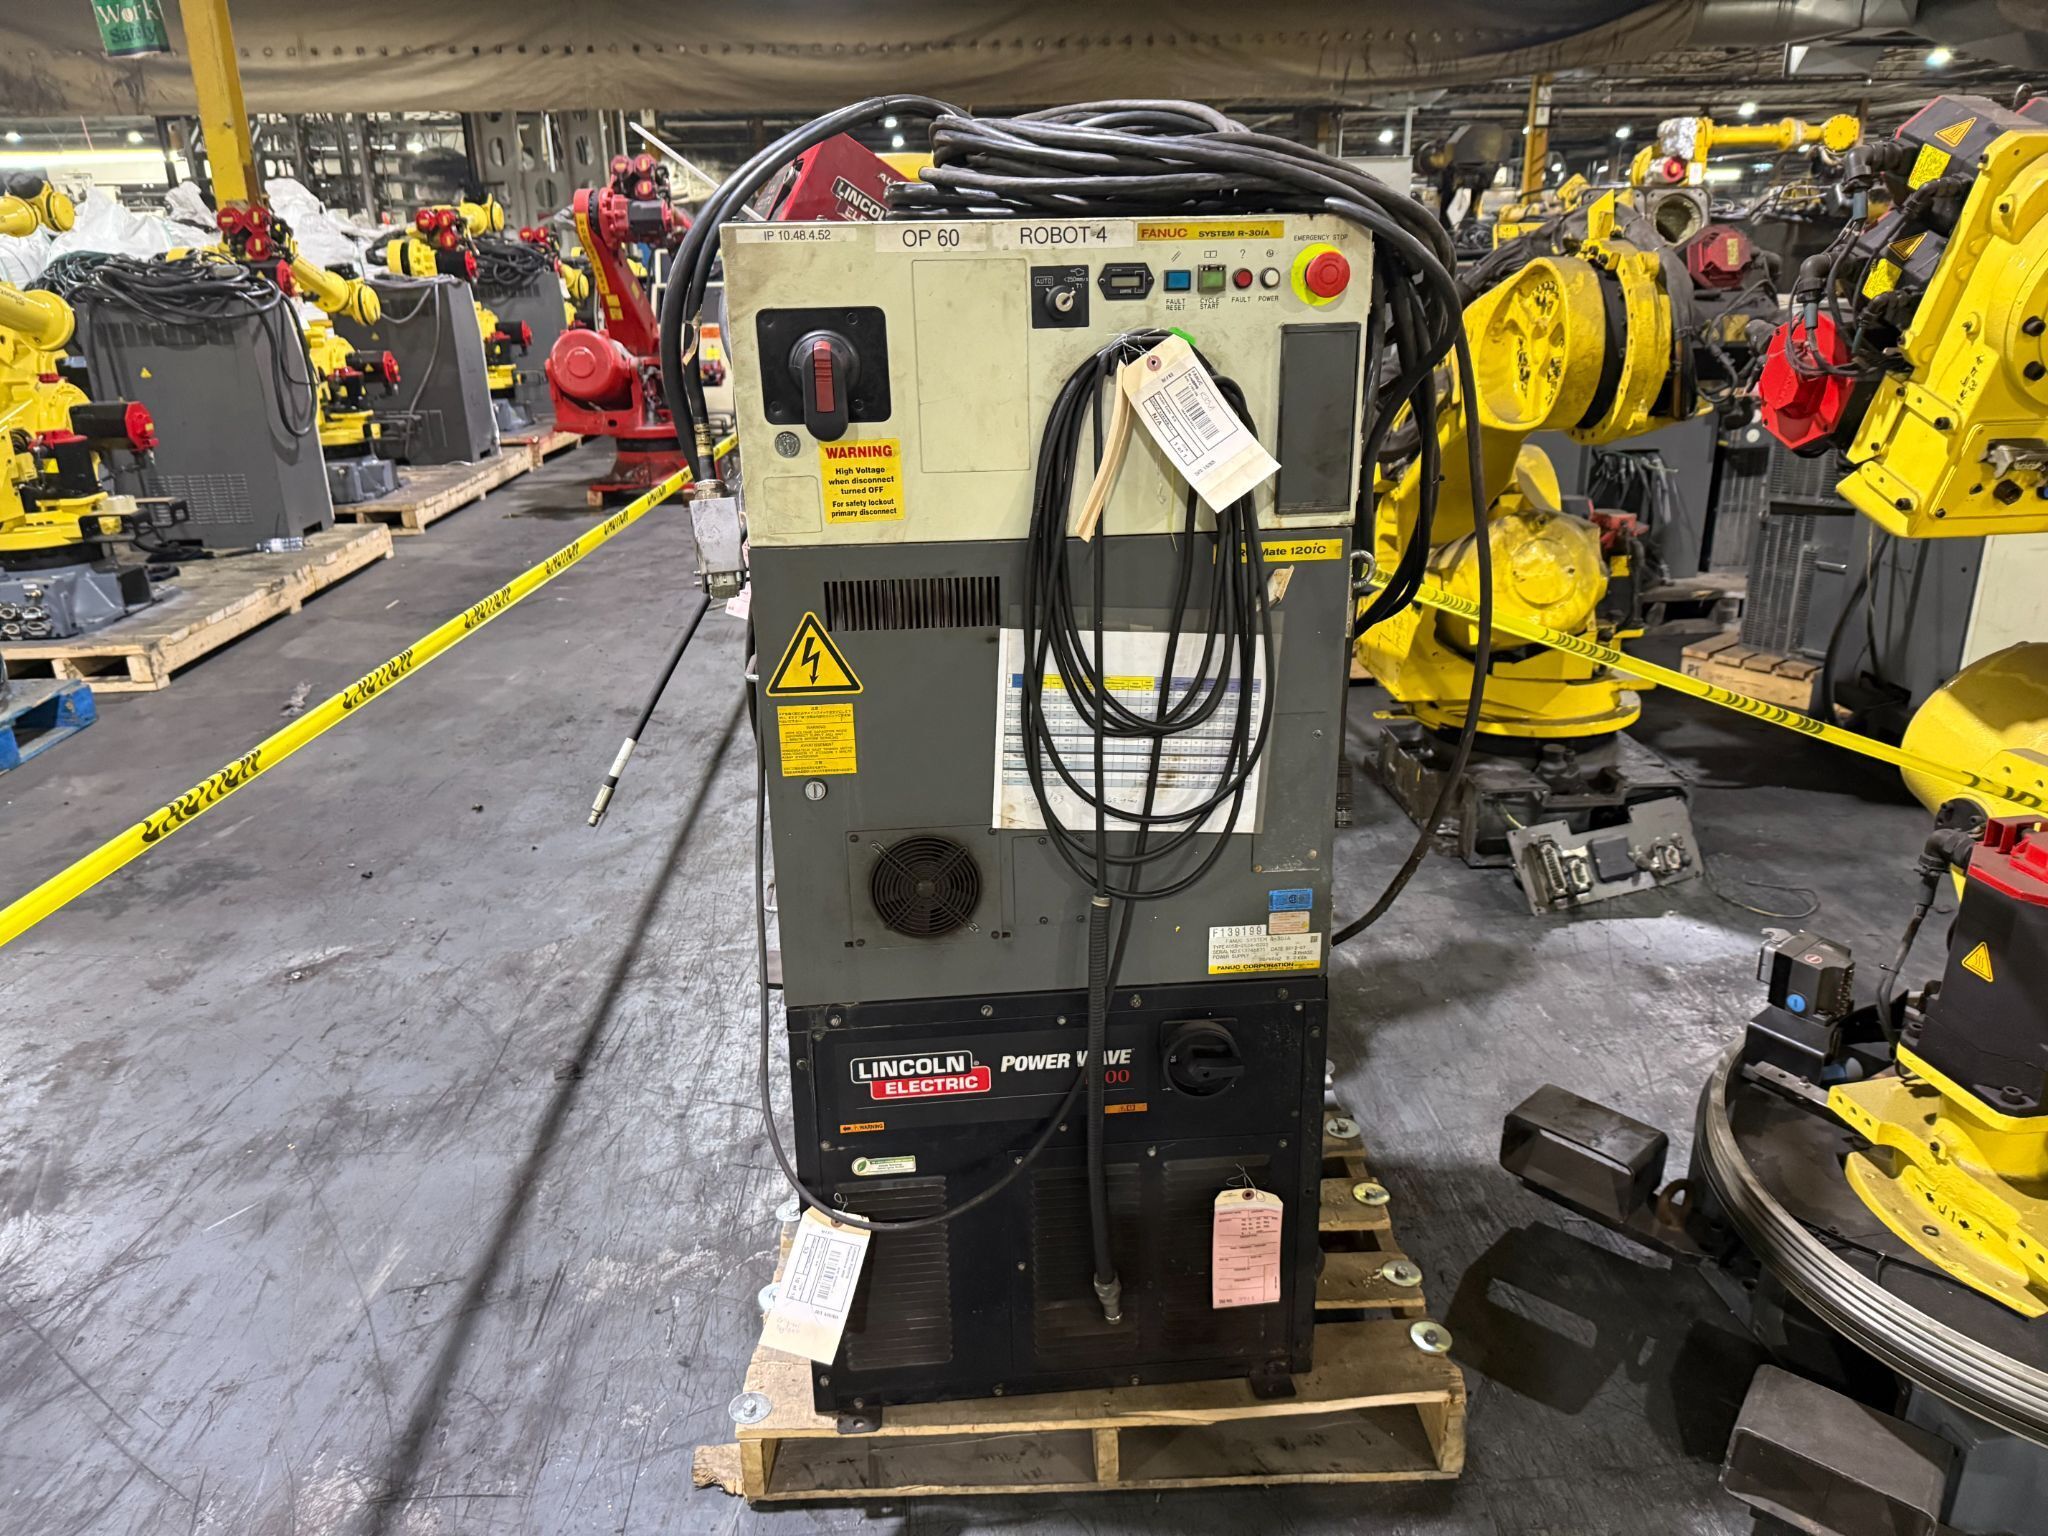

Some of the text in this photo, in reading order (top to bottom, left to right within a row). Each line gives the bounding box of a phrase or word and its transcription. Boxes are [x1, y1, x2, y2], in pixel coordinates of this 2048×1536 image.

[97, 0, 159, 24] Work
[763, 230, 831, 242] IP 10.48.4.52
[902, 228, 960, 247] OP 60
[1020, 226, 1107, 244] ROBOT 4
[1141, 226, 1270, 238] FANUC SYSTEM R-30iA
[1036, 277, 1053, 285] AUTO
[825, 445, 893, 459] WARNING
[835, 467, 885, 476] High Voltage
[828, 476, 894, 486] when disconnect
[841, 487, 866, 495] turned
[832, 498, 894, 508] For safety lockout
[831, 507, 897, 518] primary disconnect
[1291, 542, 1327, 555] 120iC
[858, 1054, 966, 1079] LINCOLN
[1000, 1052, 1071, 1073] POWER
[884, 1077, 979, 1095] ELECTRIC
